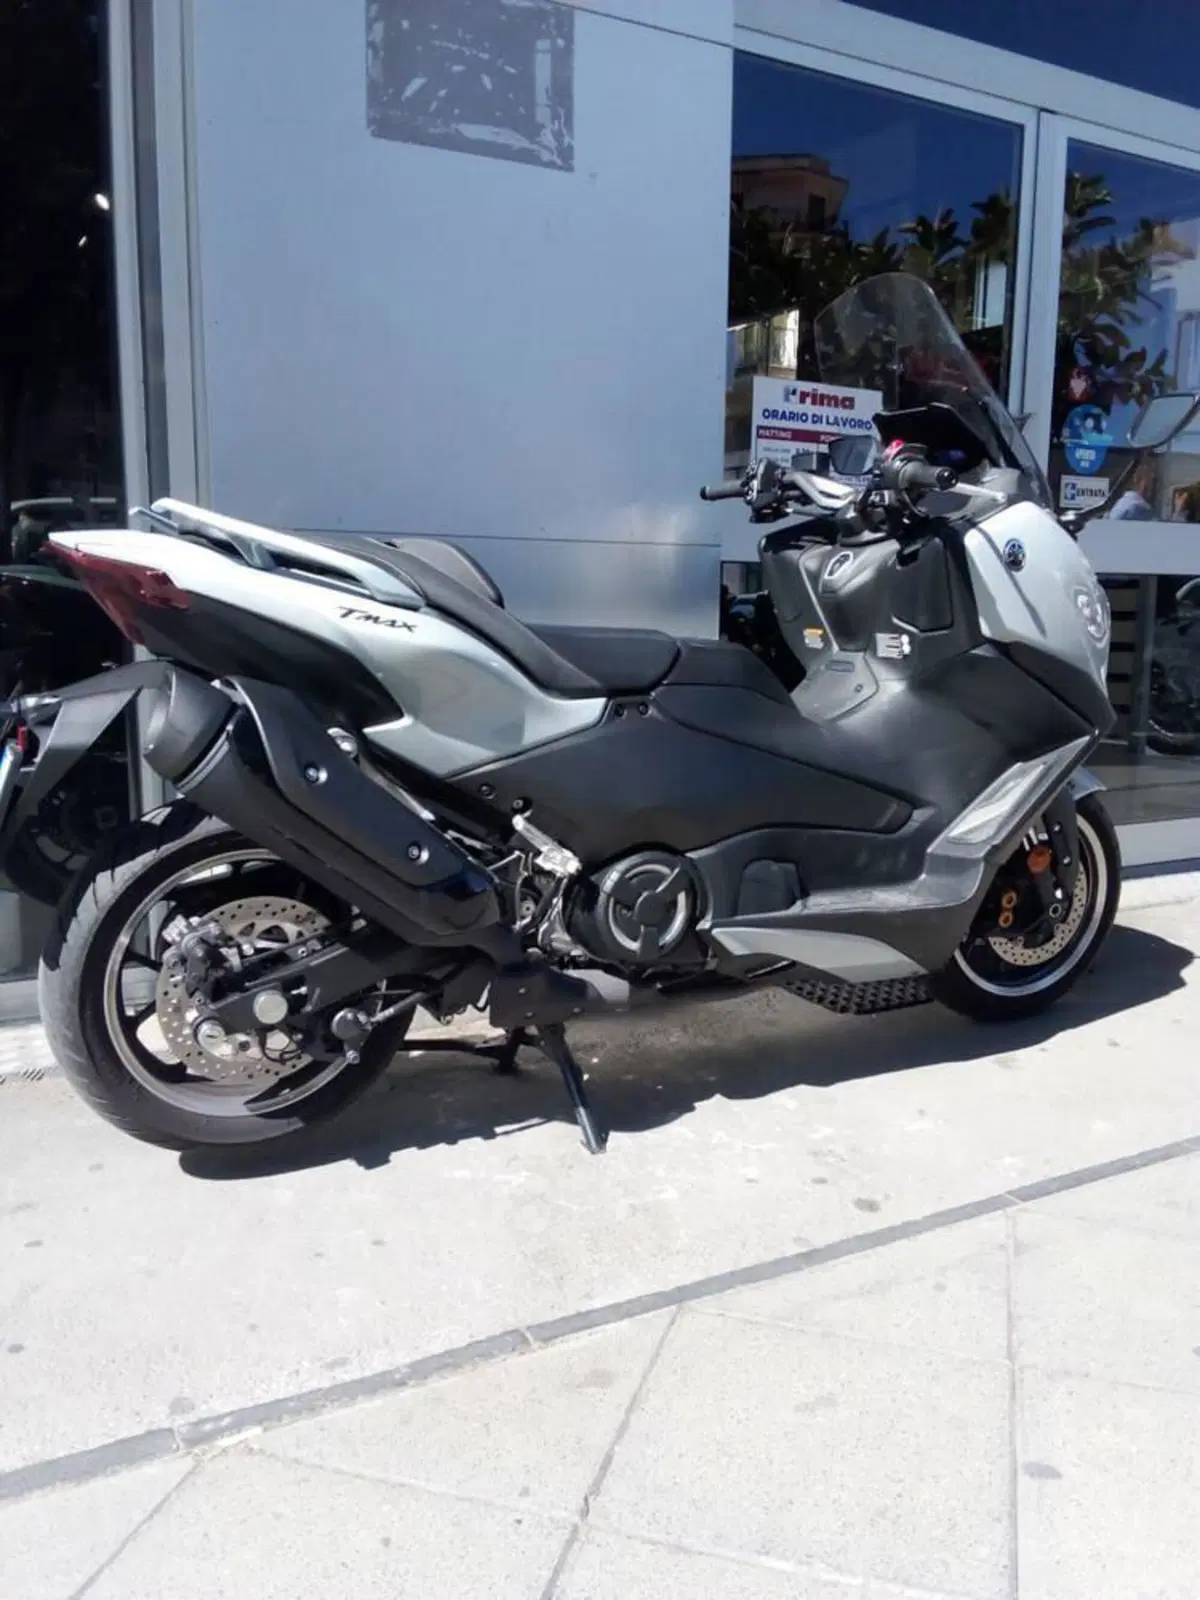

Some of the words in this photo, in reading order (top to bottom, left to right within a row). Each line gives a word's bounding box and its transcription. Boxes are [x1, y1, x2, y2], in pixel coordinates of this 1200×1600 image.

[762, 407, 809, 424] ORARIO
[811, 413, 824, 425] DI
[826, 415, 873, 431] LAVORO
